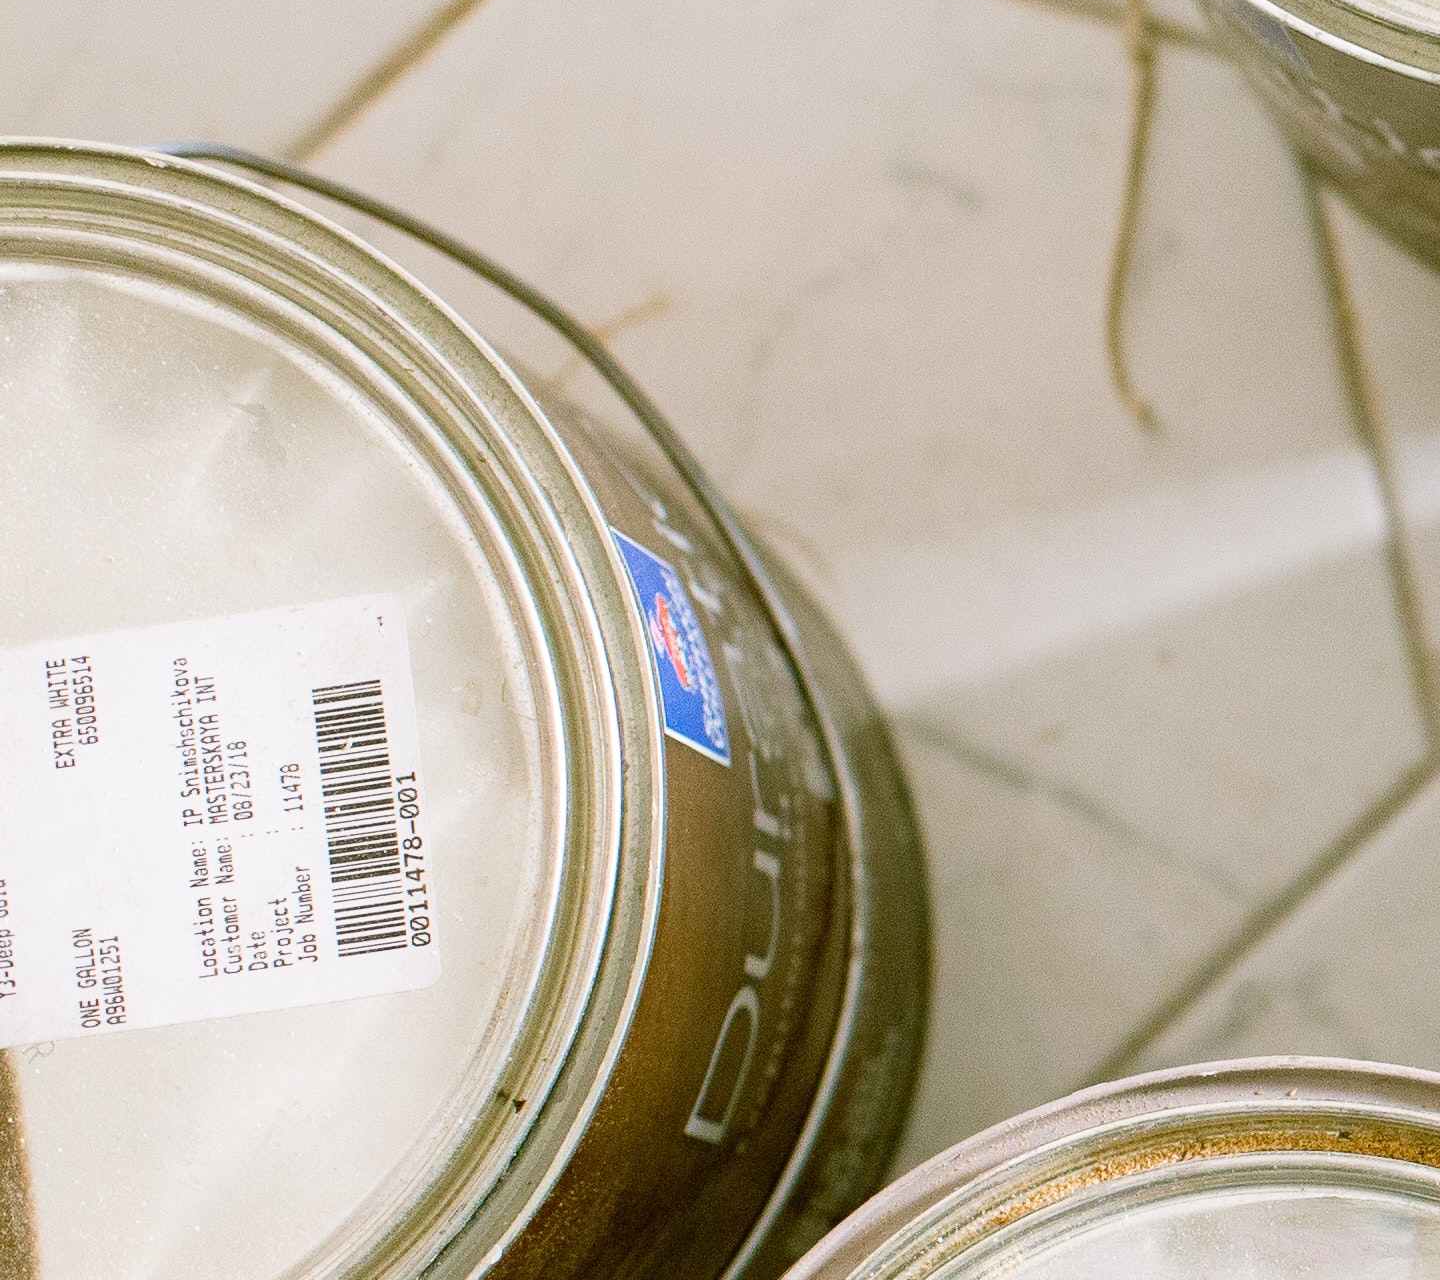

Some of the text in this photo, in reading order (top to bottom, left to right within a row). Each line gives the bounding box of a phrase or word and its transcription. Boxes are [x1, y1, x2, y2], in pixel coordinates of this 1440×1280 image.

[44, 657, 102, 1029] ONE GALLON EXTRA WHITE
[69, 654, 127, 1025] A96W01251 650096514
[169, 656, 219, 979] Location Name: IP Snimshschikova
[192, 675, 244, 975] Customer Name: MASTERSKAYA INT
[225, 739, 269, 972] Date 08/23/18
[266, 896, 295, 968] Project
[278, 762, 319, 963] Job Number 11478
[389, 770, 431, 947] 0011478-001
